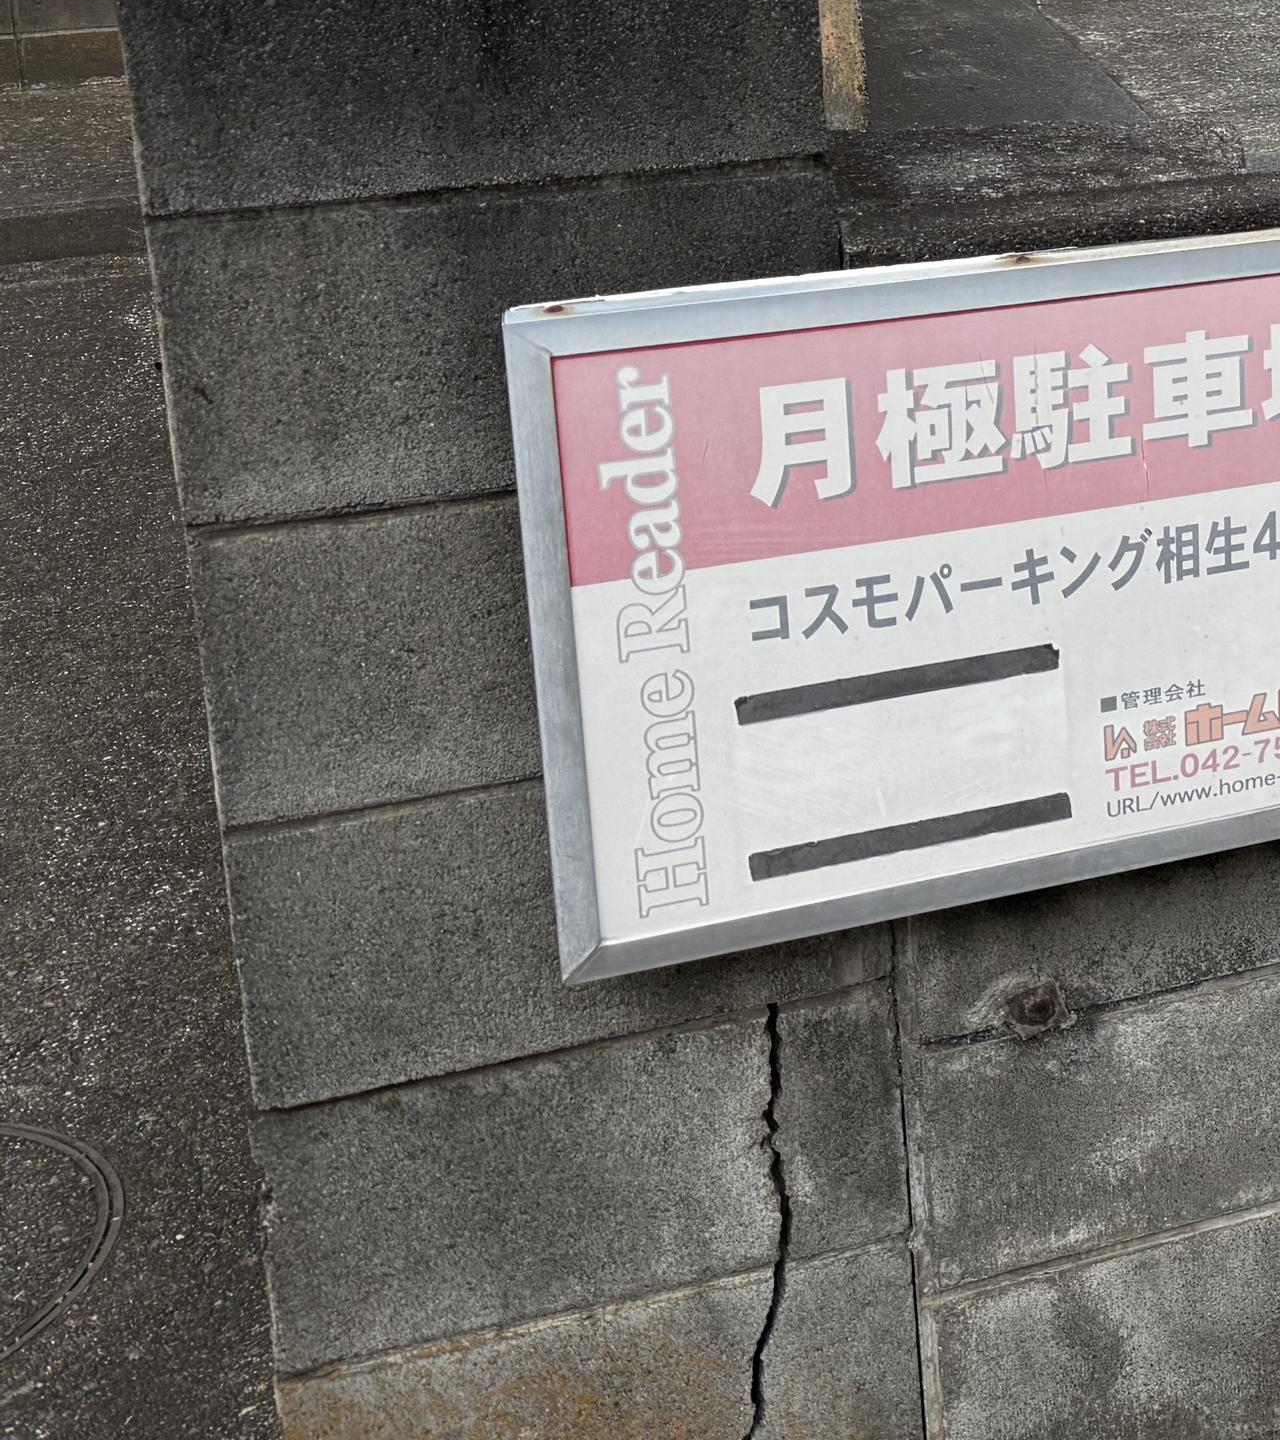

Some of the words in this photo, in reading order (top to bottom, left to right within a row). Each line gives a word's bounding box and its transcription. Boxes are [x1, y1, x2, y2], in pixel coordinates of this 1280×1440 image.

[597, 366, 690, 663] Reader
[635, 669, 709, 918] Home
[1121, 679, 1206, 710] 管理会社
